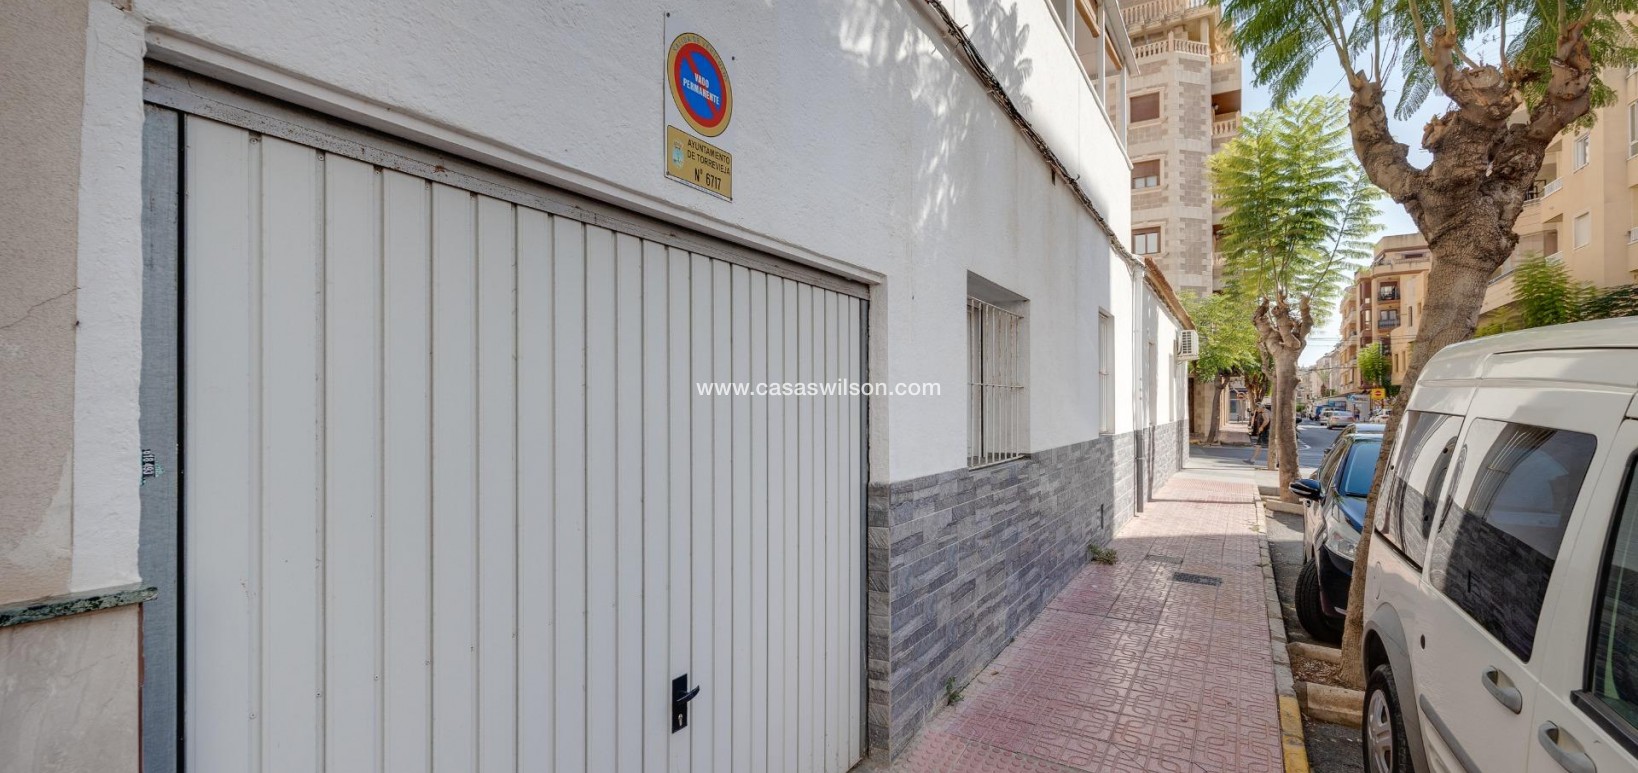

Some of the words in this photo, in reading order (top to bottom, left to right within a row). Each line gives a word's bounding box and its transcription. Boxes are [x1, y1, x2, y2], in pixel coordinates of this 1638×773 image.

[682, 77, 720, 105] PERMANENTE
[694, 72, 709, 88] VADO
[687, 139, 730, 164] AYUNTAMIENTO
[687, 149, 696, 161] DE
[697, 153, 731, 175] TORREVIEJA
[705, 172, 722, 191] 6717
